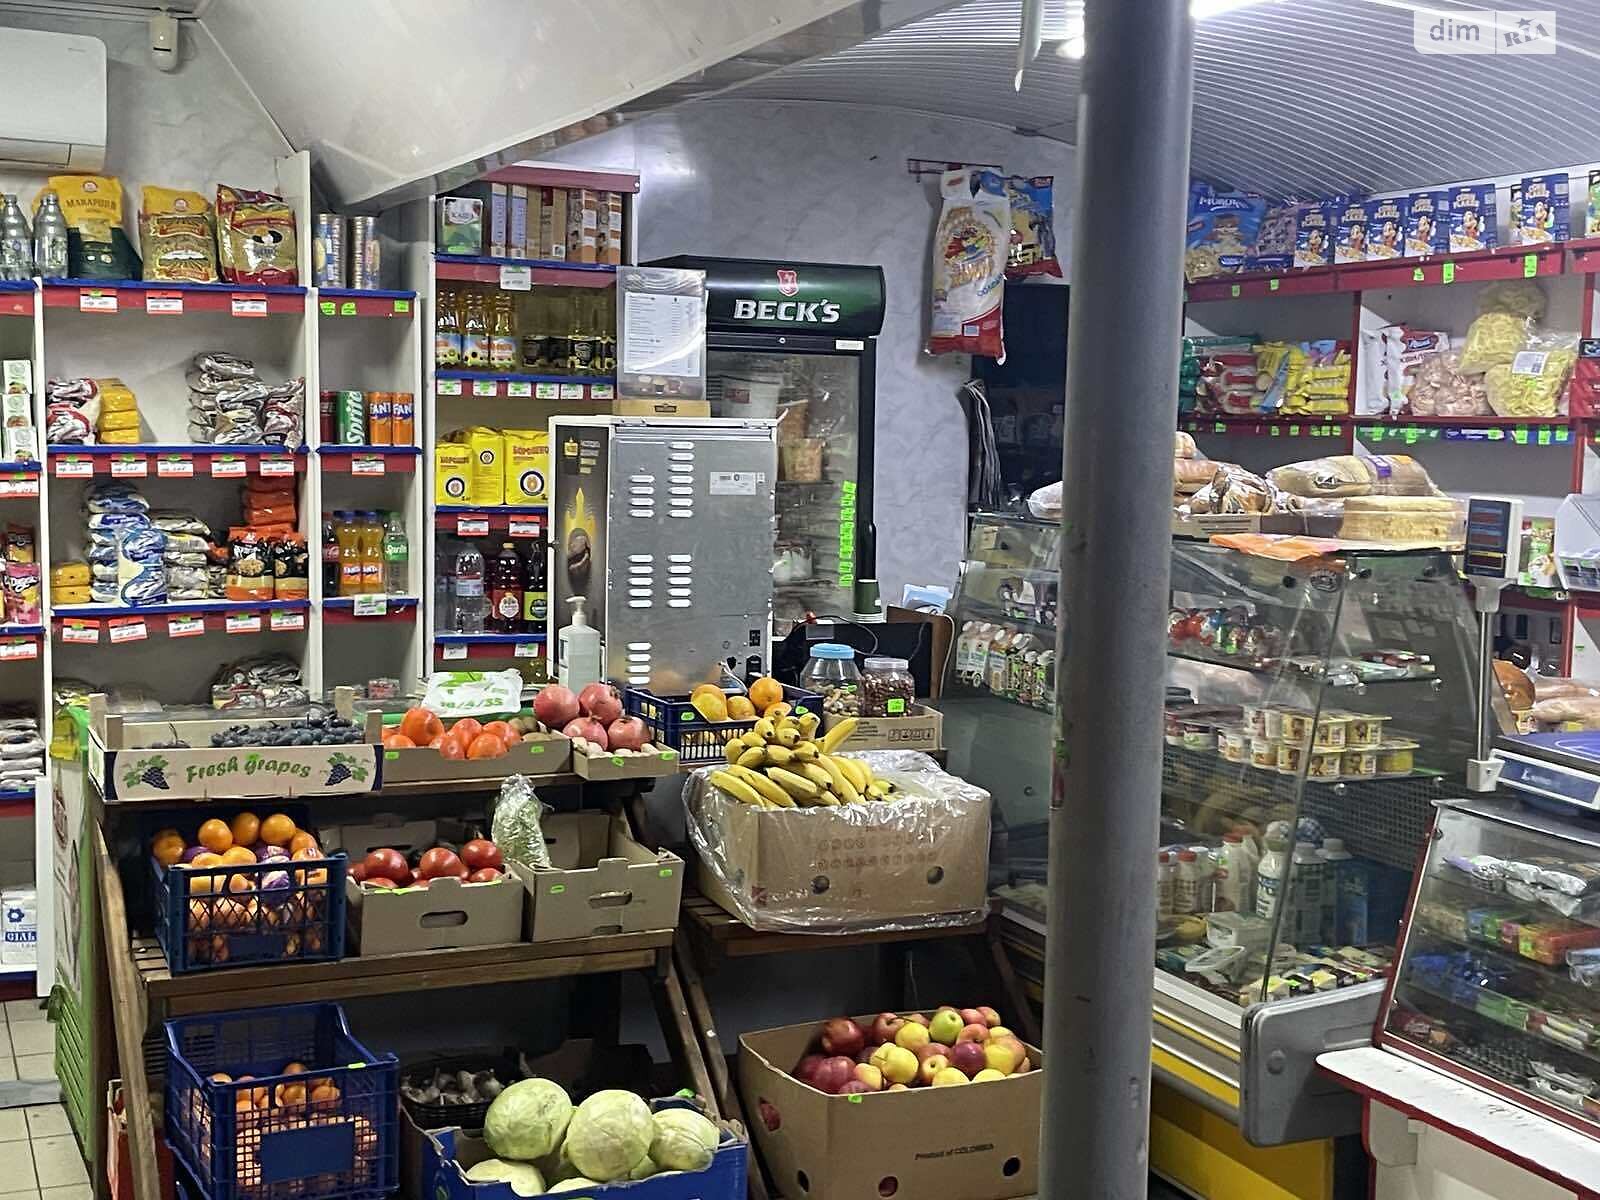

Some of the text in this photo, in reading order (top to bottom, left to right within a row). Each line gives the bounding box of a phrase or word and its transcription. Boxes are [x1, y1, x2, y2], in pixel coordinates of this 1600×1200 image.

[733, 298, 841, 323] BECK'S
[346, 388, 365, 443] Sprite
[186, 756, 312, 783] Fresh grapes
